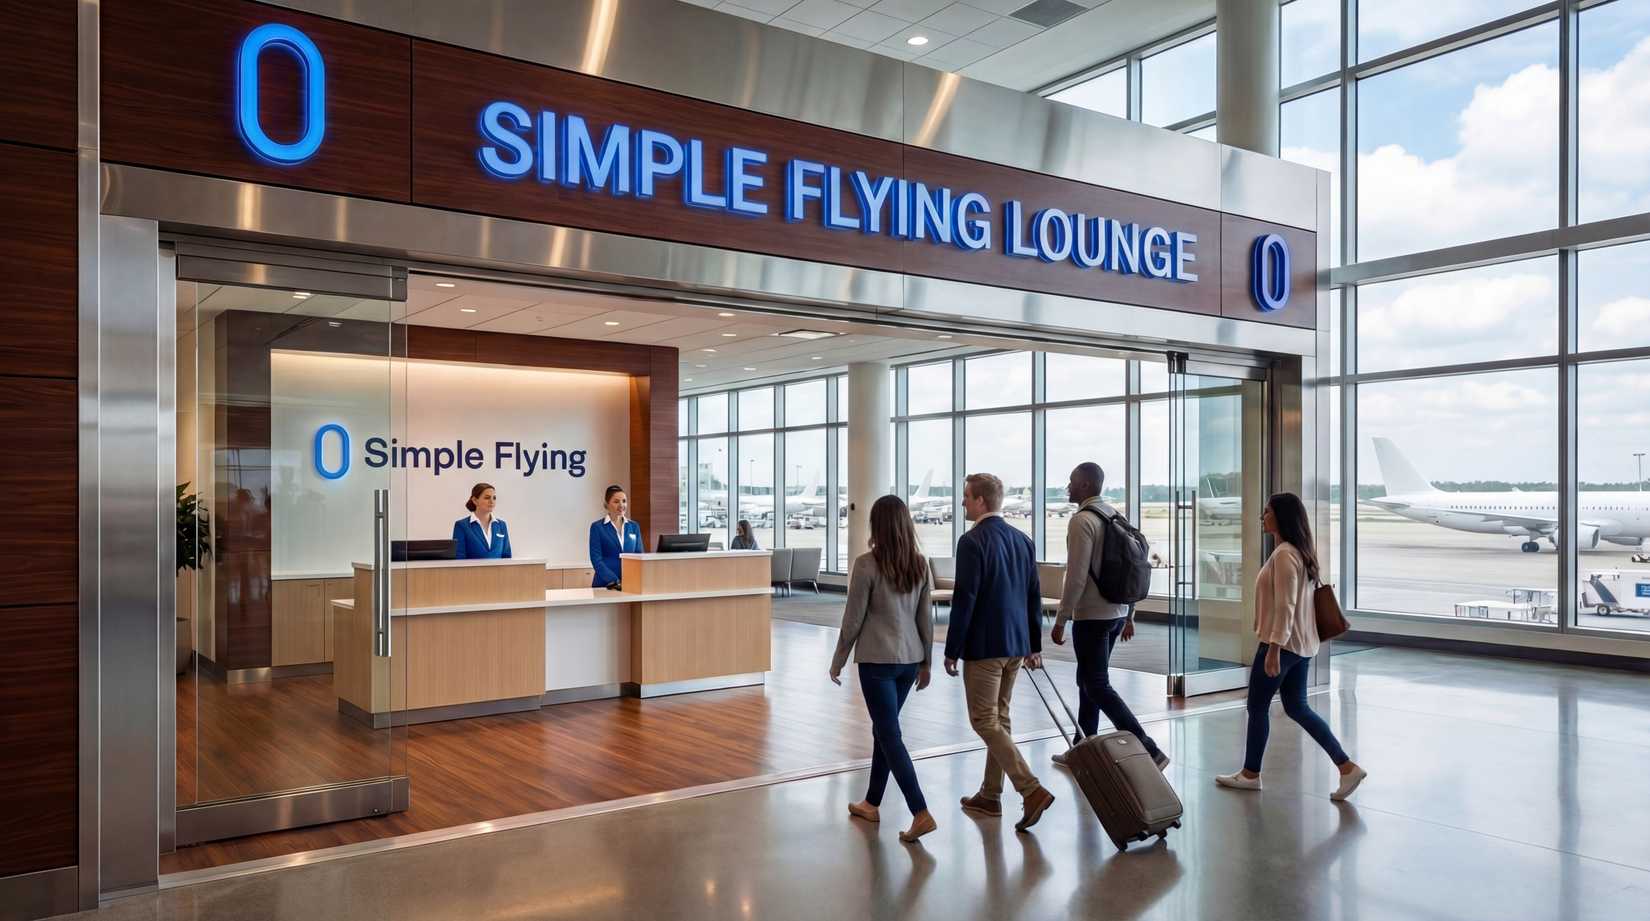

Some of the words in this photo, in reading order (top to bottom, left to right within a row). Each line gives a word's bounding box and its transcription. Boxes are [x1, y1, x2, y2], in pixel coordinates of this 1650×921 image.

[479, 101, 769, 215] SIMPLE
[785, 159, 992, 250] FLYING
[1004, 201, 1199, 283] LOUNGE
[364, 437, 484, 475] Simple
[495, 441, 587, 478] Flying
